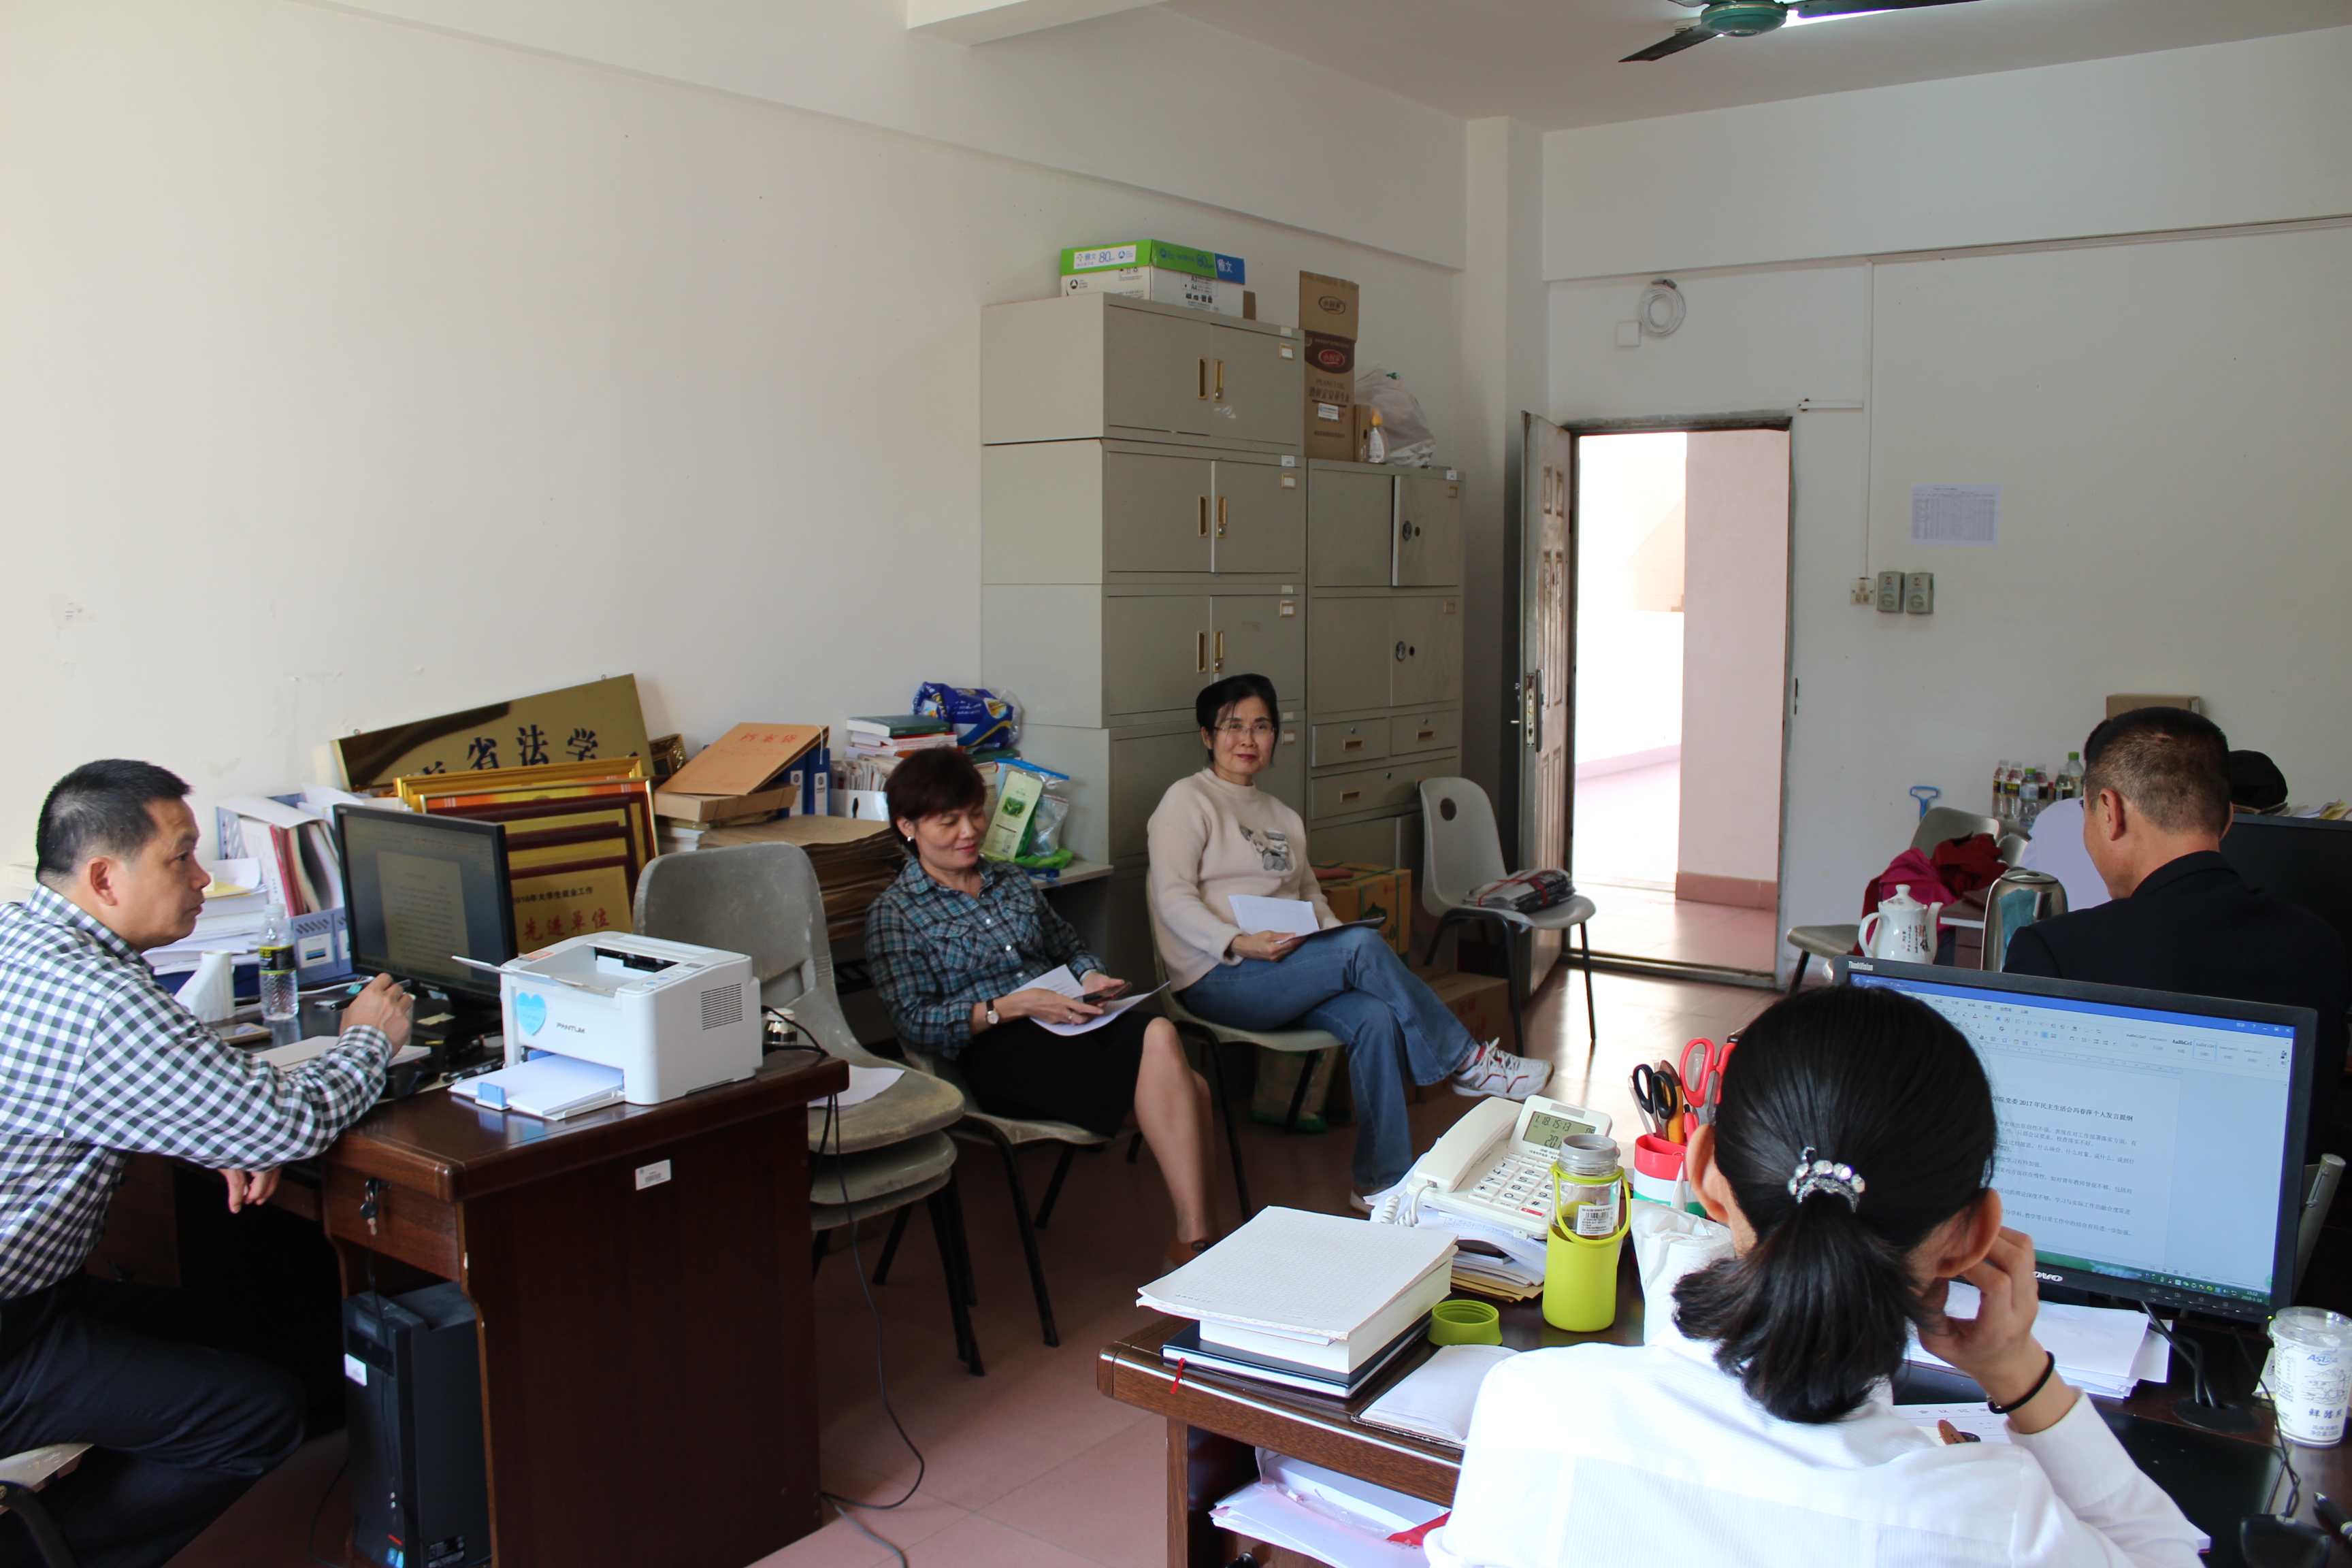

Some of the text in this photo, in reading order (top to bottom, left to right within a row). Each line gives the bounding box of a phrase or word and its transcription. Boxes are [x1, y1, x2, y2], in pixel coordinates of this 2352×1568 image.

[1099, 251, 1111, 263] 80
[1196, 254, 1209, 269] 80
[1217, 259, 1233, 273] 雅文
[422, 724, 638, 774] 省法学
[525, 907, 611, 942] 先进单位
[1848, 960, 1874, 971] ThinkVision
[556, 1022, 585, 1034] PANTUM
